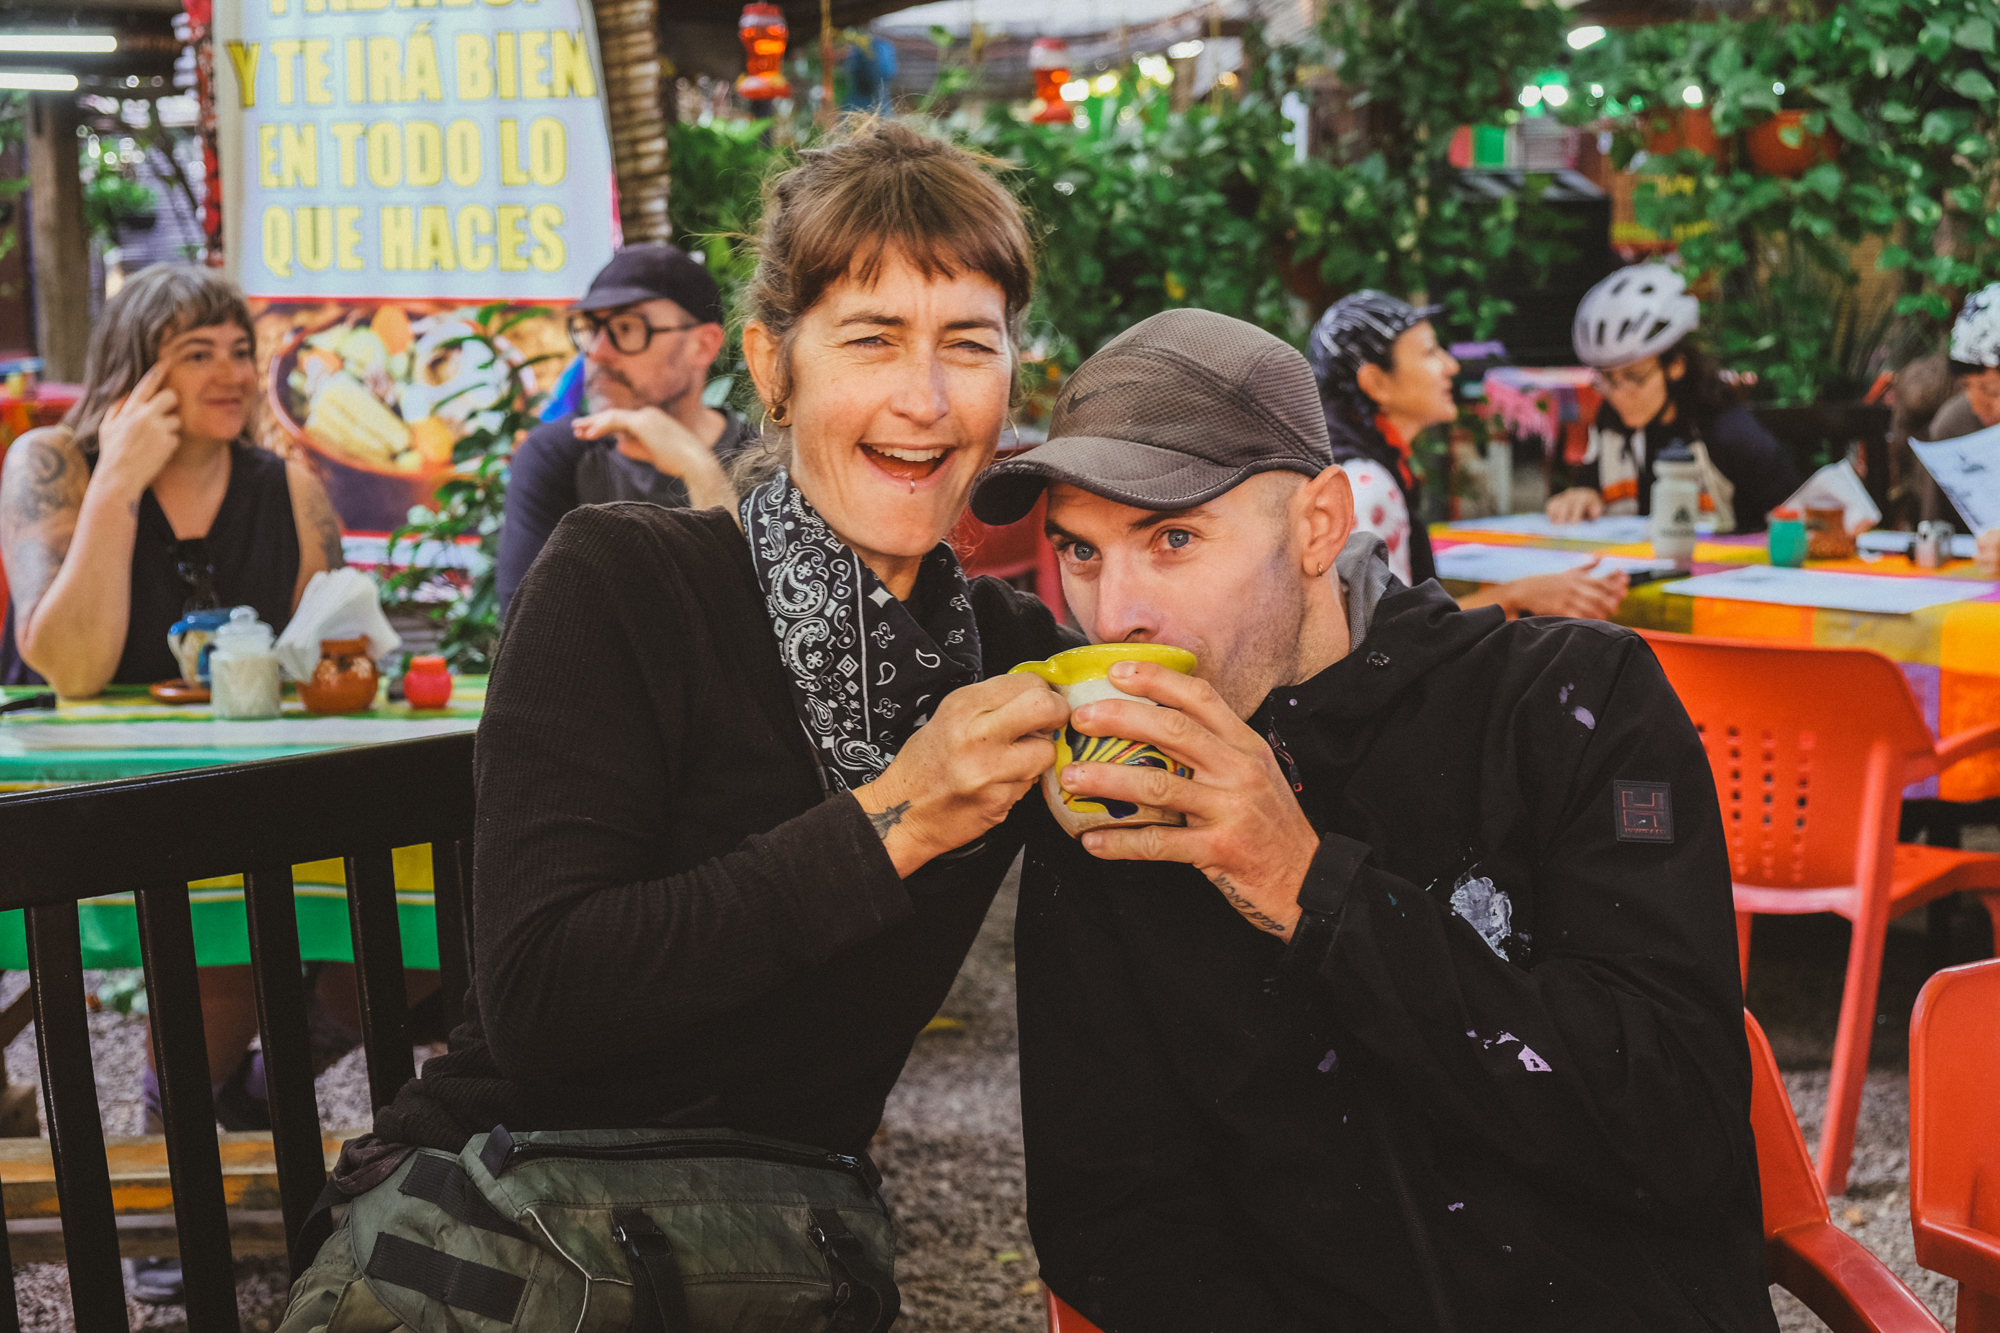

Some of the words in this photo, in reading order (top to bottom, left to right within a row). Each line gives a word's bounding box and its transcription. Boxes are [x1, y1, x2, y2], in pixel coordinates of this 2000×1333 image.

[226, 41, 260, 107] Y
[270, 40, 332, 104] TE
[346, 22, 443, 104] IRÁ
[456, 30, 597, 100] BIEN
[259, 123, 318, 188] EN
[332, 119, 481, 188] TODO
[500, 117, 567, 187] LO
[262, 205, 364, 278] QUE
[381, 204, 566, 272] HACES
